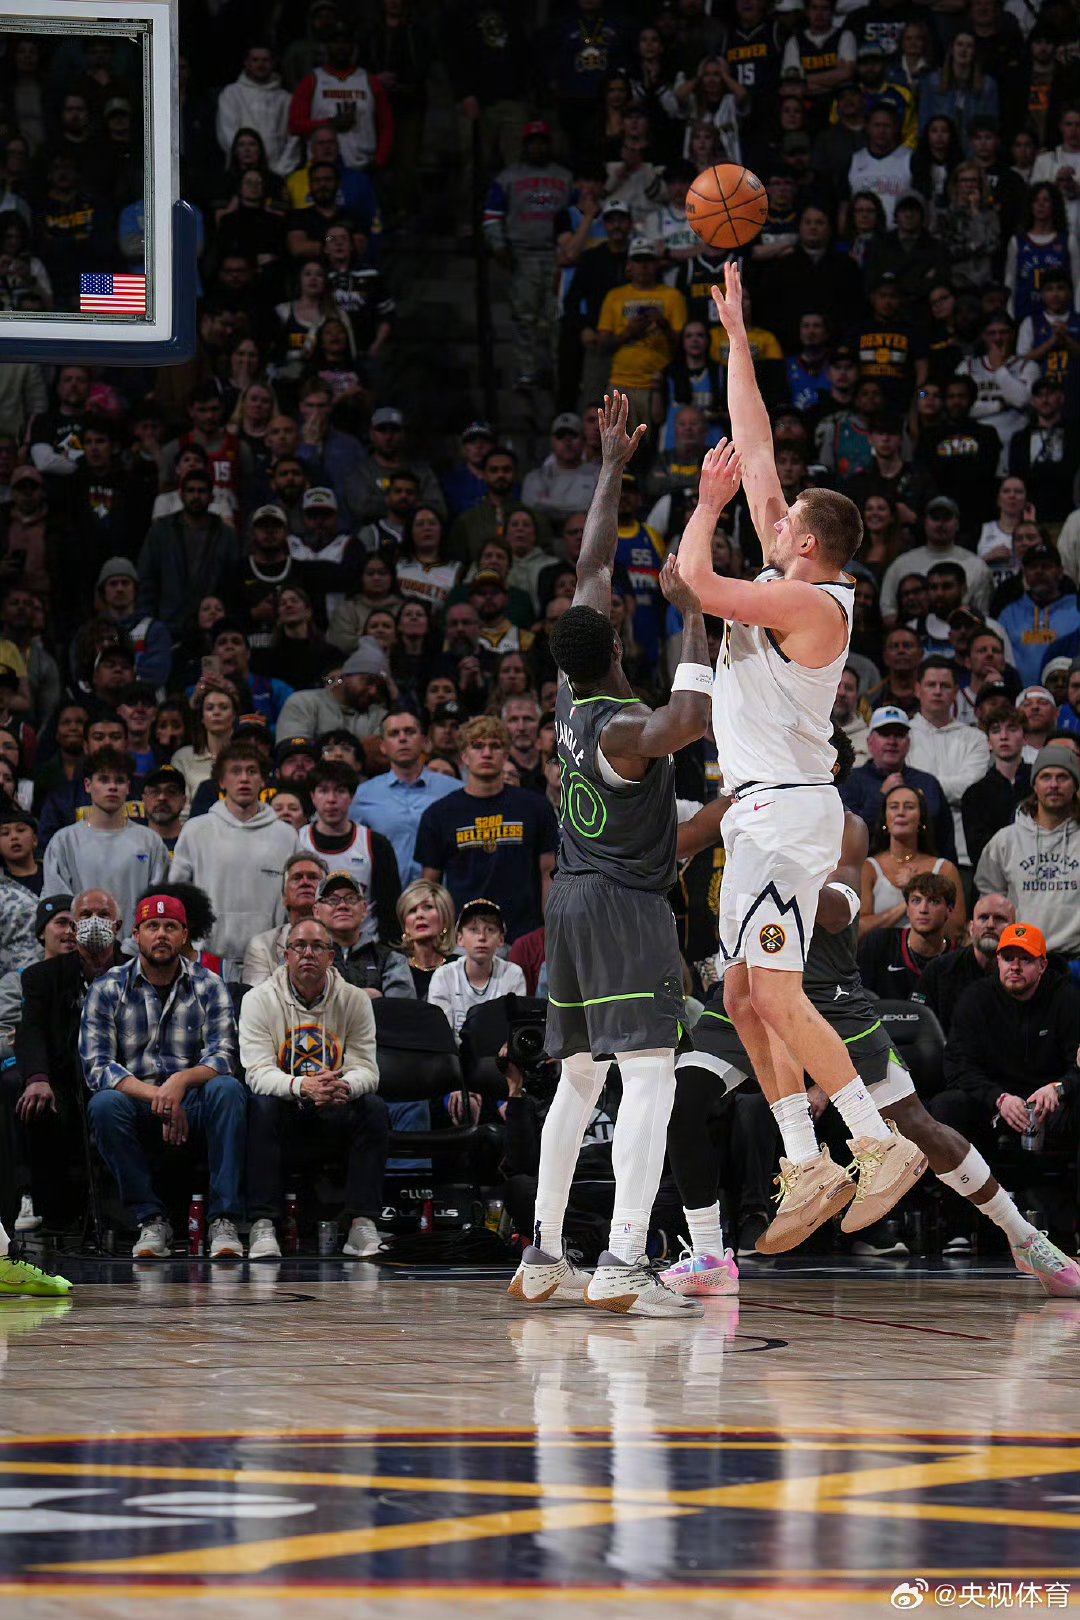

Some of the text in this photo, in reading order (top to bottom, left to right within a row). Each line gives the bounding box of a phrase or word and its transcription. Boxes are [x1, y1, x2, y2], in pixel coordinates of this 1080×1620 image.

[736, 62, 756, 86] 15
[213, 460, 232, 482] 15
[555, 719, 585, 768] ANDLE
[456, 824, 524, 845] RELENTLESS
[1023, 880, 1078, 891] NUGGETS
[960, 1173, 970, 1184] 5
[400, 1188, 434, 1200] CLUB
